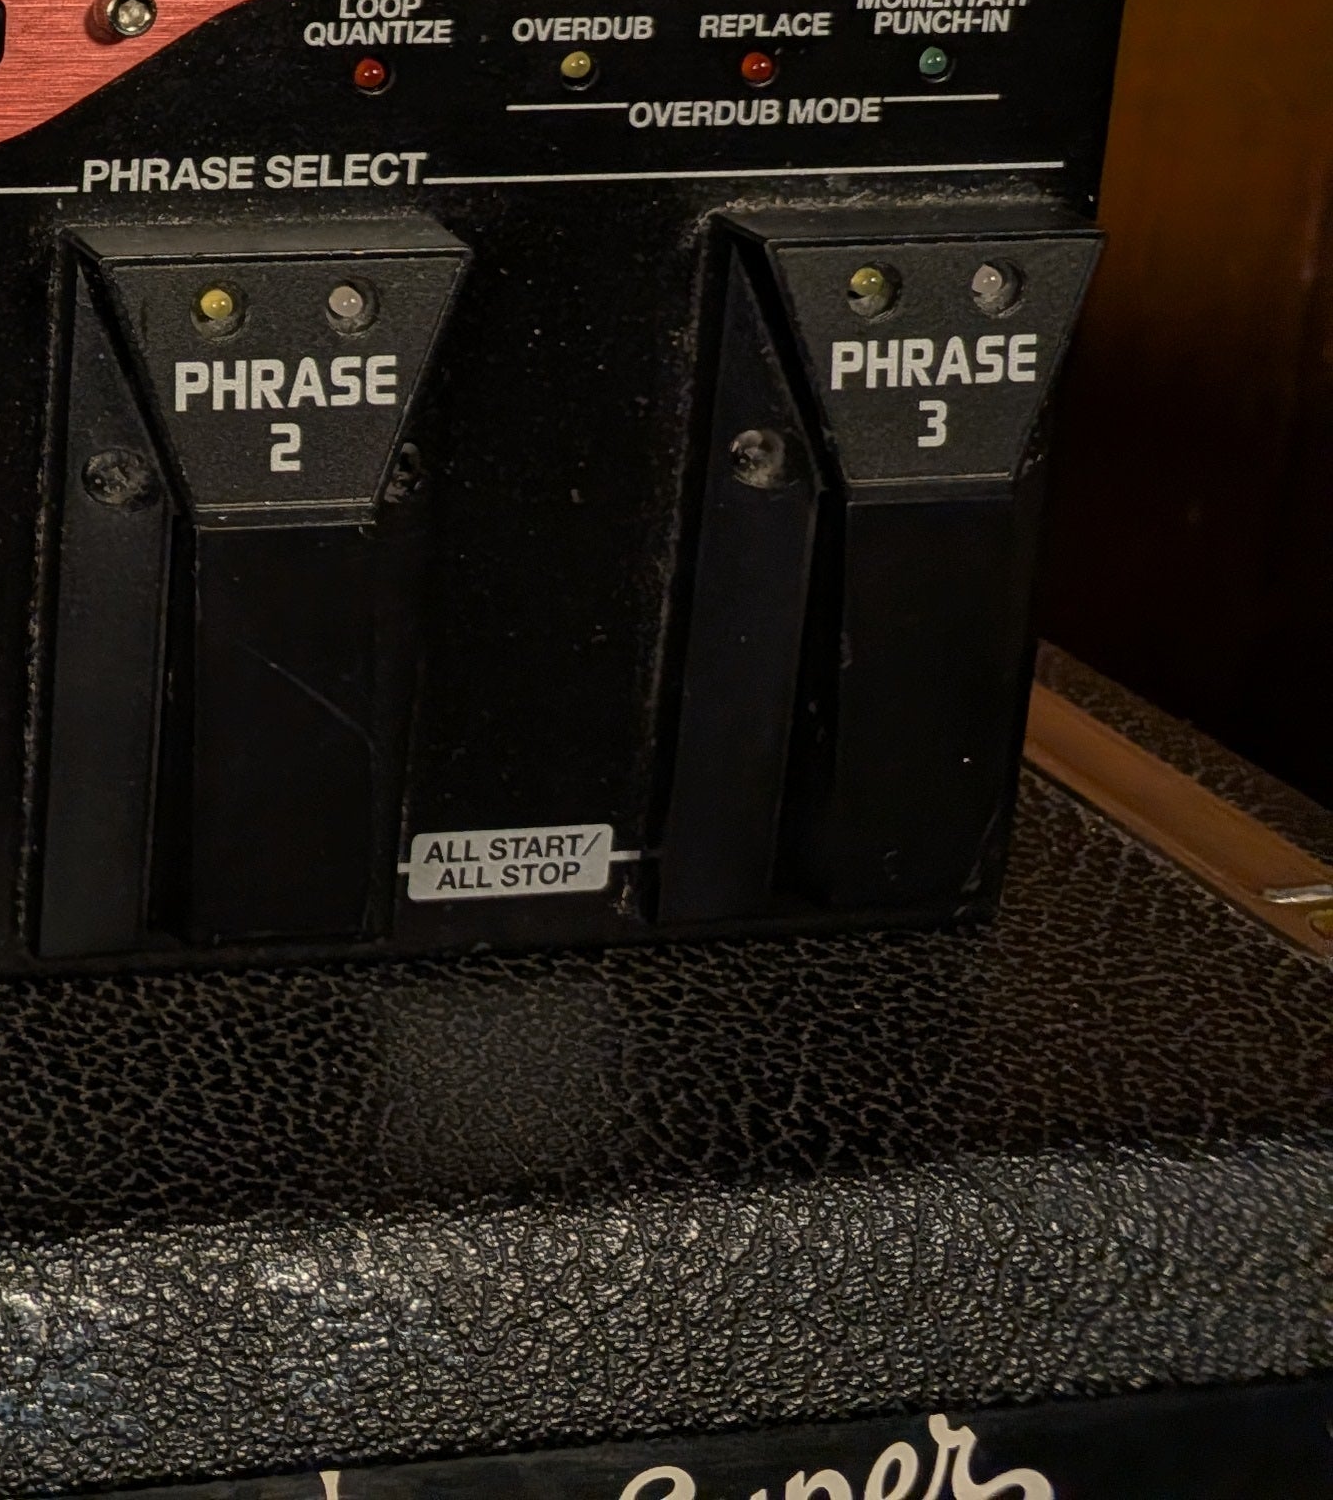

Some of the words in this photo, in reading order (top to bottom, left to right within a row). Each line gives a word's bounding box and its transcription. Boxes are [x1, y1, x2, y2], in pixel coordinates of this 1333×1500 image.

[304, 18, 453, 47] QUANTIZE
[512, 15, 654, 42] OVERDUB
[699, 11, 833, 39] REPLACE
[874, 7, 1011, 35] PUNCH-IN
[628, 99, 780, 128] OVERDUB
[787, 97, 881, 124] MODE
[82, 157, 255, 193] PHRASE
[265, 154, 426, 190] SELECT
[830, 335, 1038, 390] PHRASE
[175, 355, 397, 411] PHRASE
[917, 401, 947, 448] 3
[269, 424, 302, 472] 2
[424, 841, 479, 863] ALL
[489, 832, 602, 861] START/
[436, 867, 492, 890] ALL
[501, 862, 580, 886] STOP
